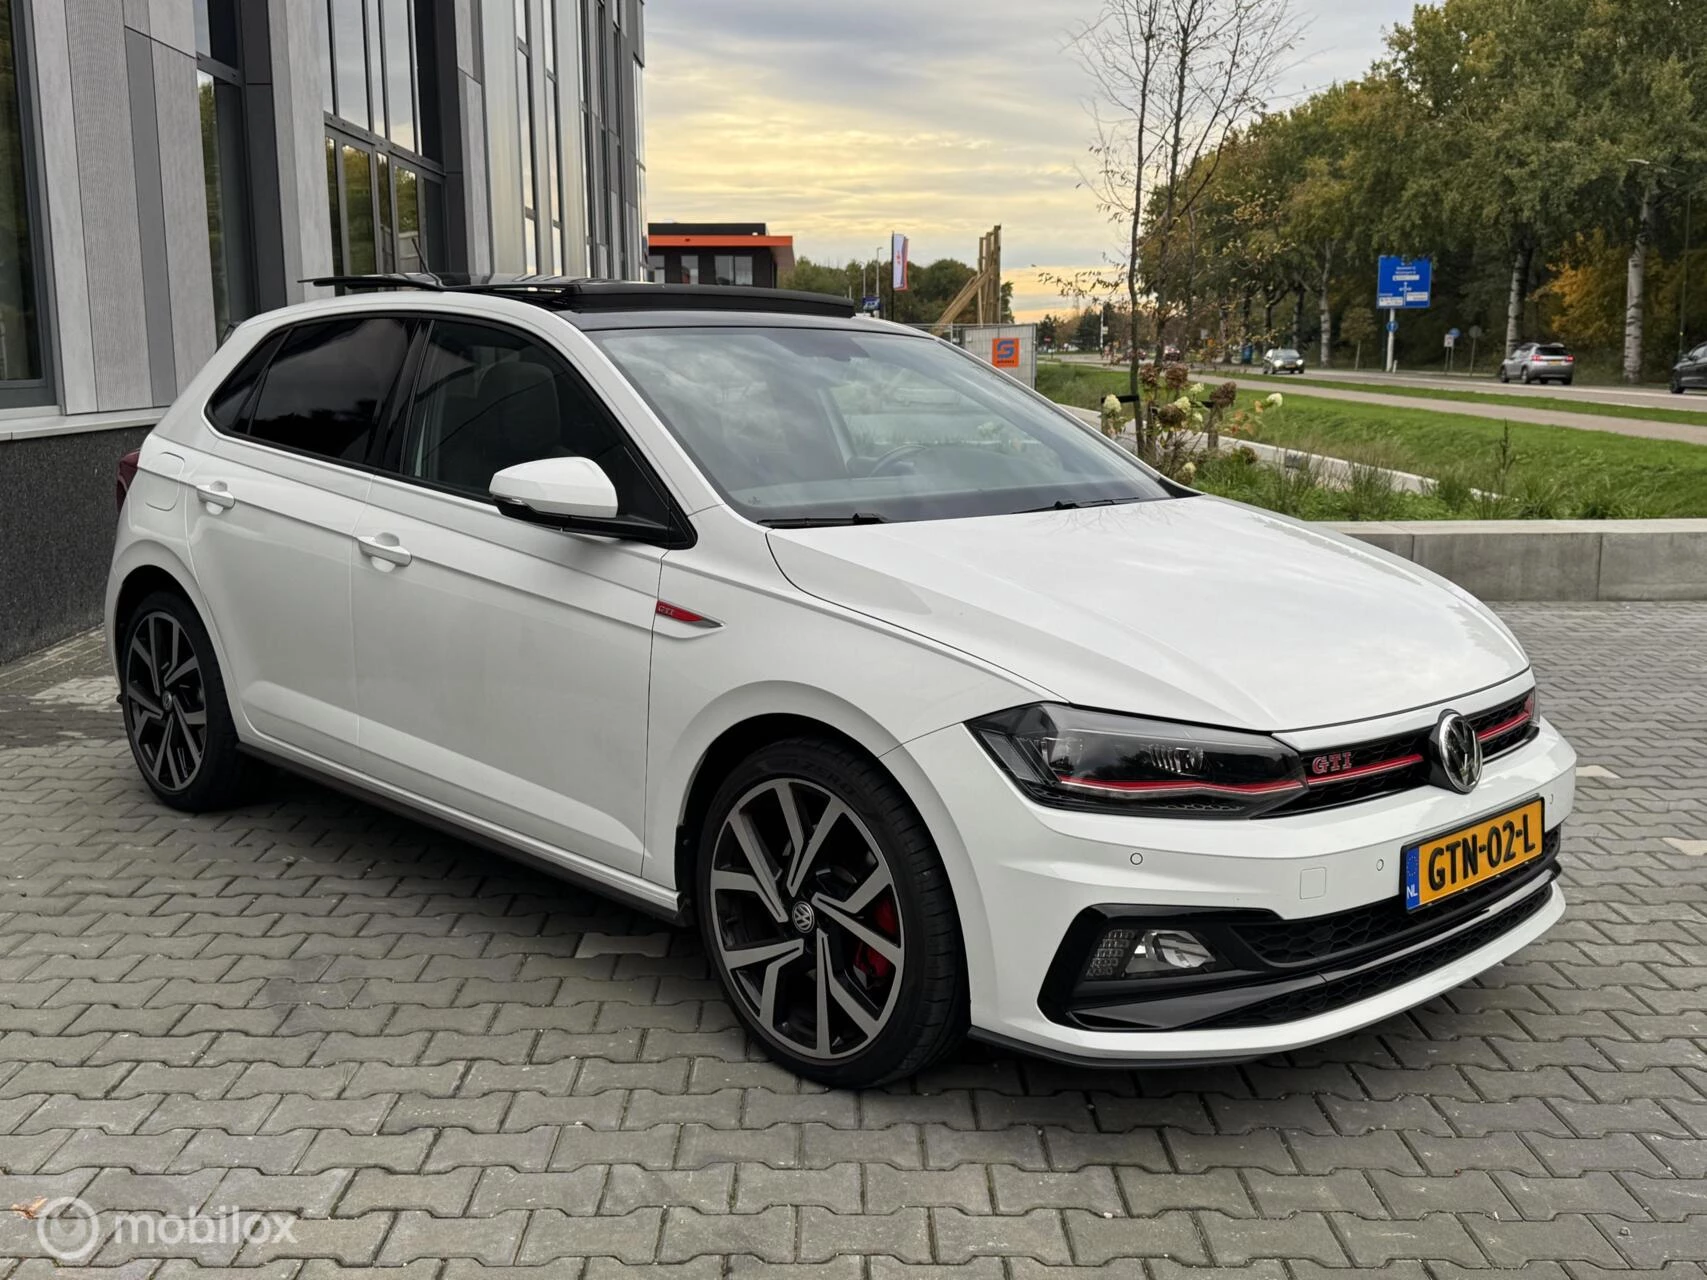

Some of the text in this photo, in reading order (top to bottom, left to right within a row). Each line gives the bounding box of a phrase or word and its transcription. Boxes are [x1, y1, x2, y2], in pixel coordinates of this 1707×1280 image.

[659, 605, 673, 616] GTI
[1312, 752, 1352, 774] GTI
[1428, 813, 1536, 891] GTN-02-L
[1406, 884, 1418, 899] NL
